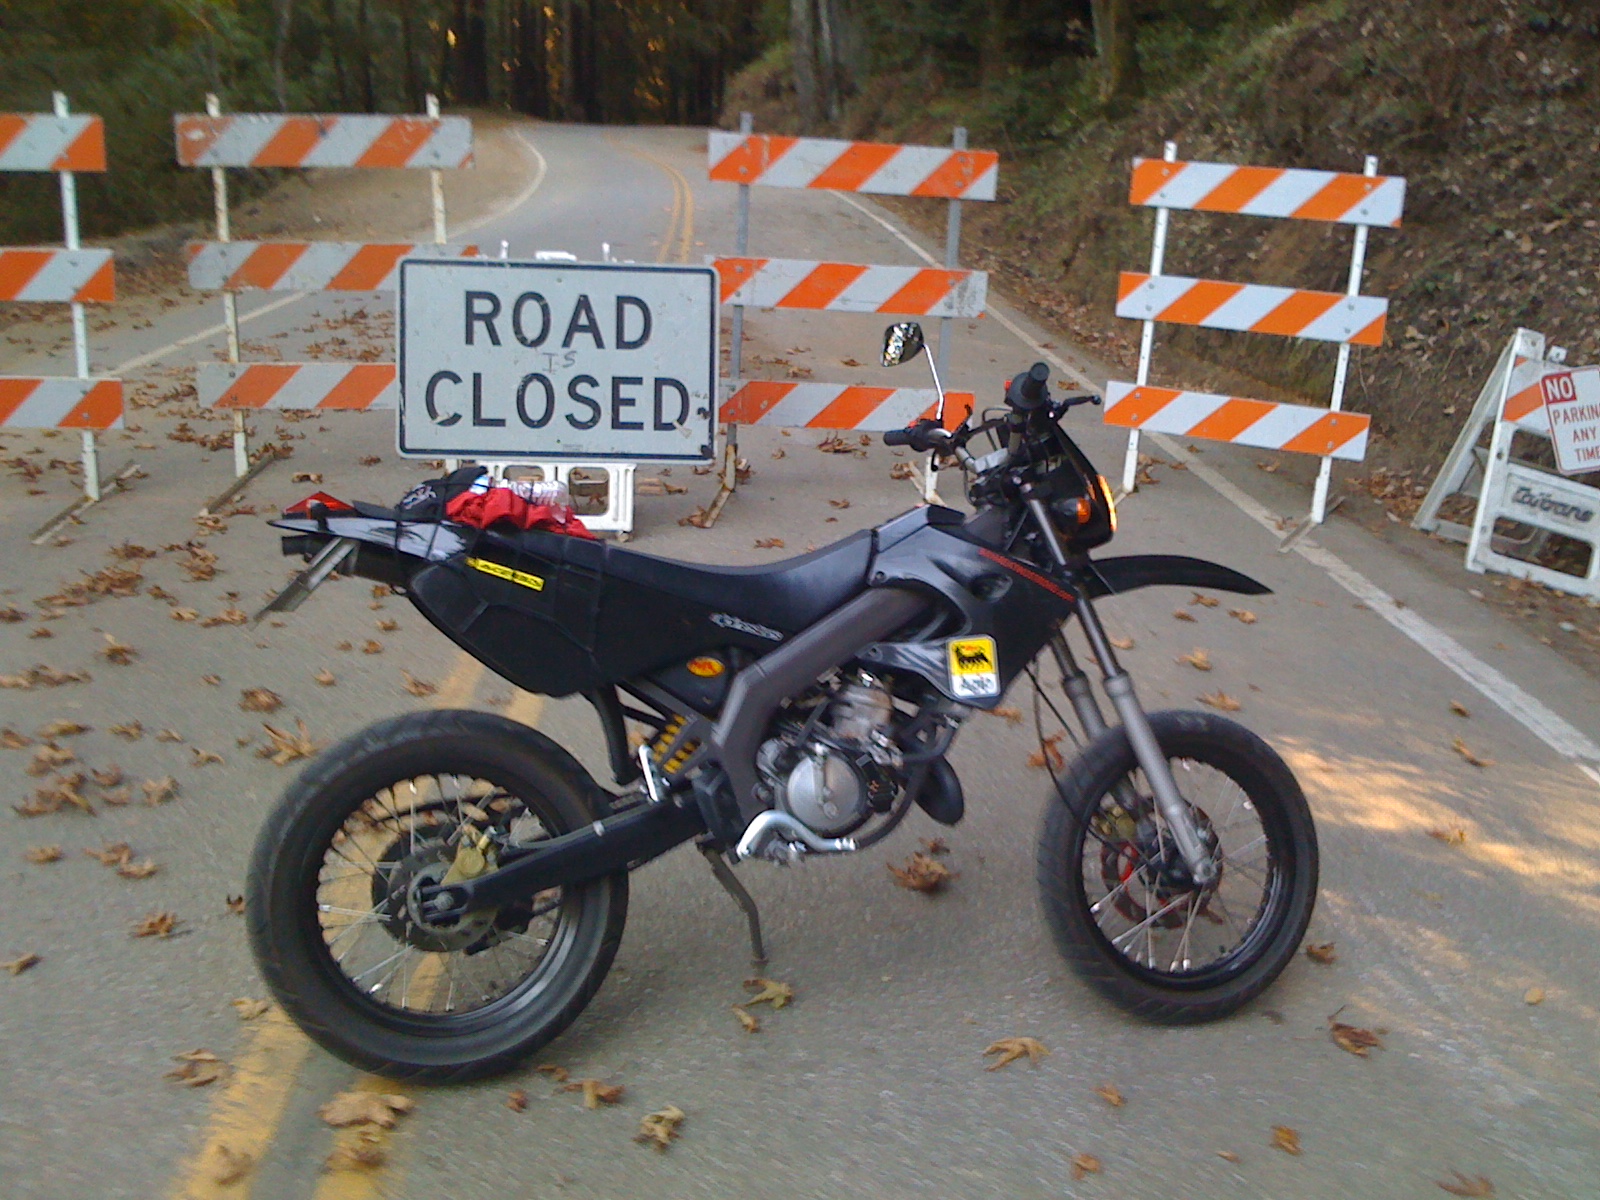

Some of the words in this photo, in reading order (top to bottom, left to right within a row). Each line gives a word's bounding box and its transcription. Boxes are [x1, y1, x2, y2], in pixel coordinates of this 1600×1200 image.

[465, 290, 652, 350] ROAD
[425, 370, 690, 432] CLOSED
[1545, 375, 1574, 401] NO
[1552, 403, 1600, 425] PARKIN
[1573, 427, 1596, 443] ANY
